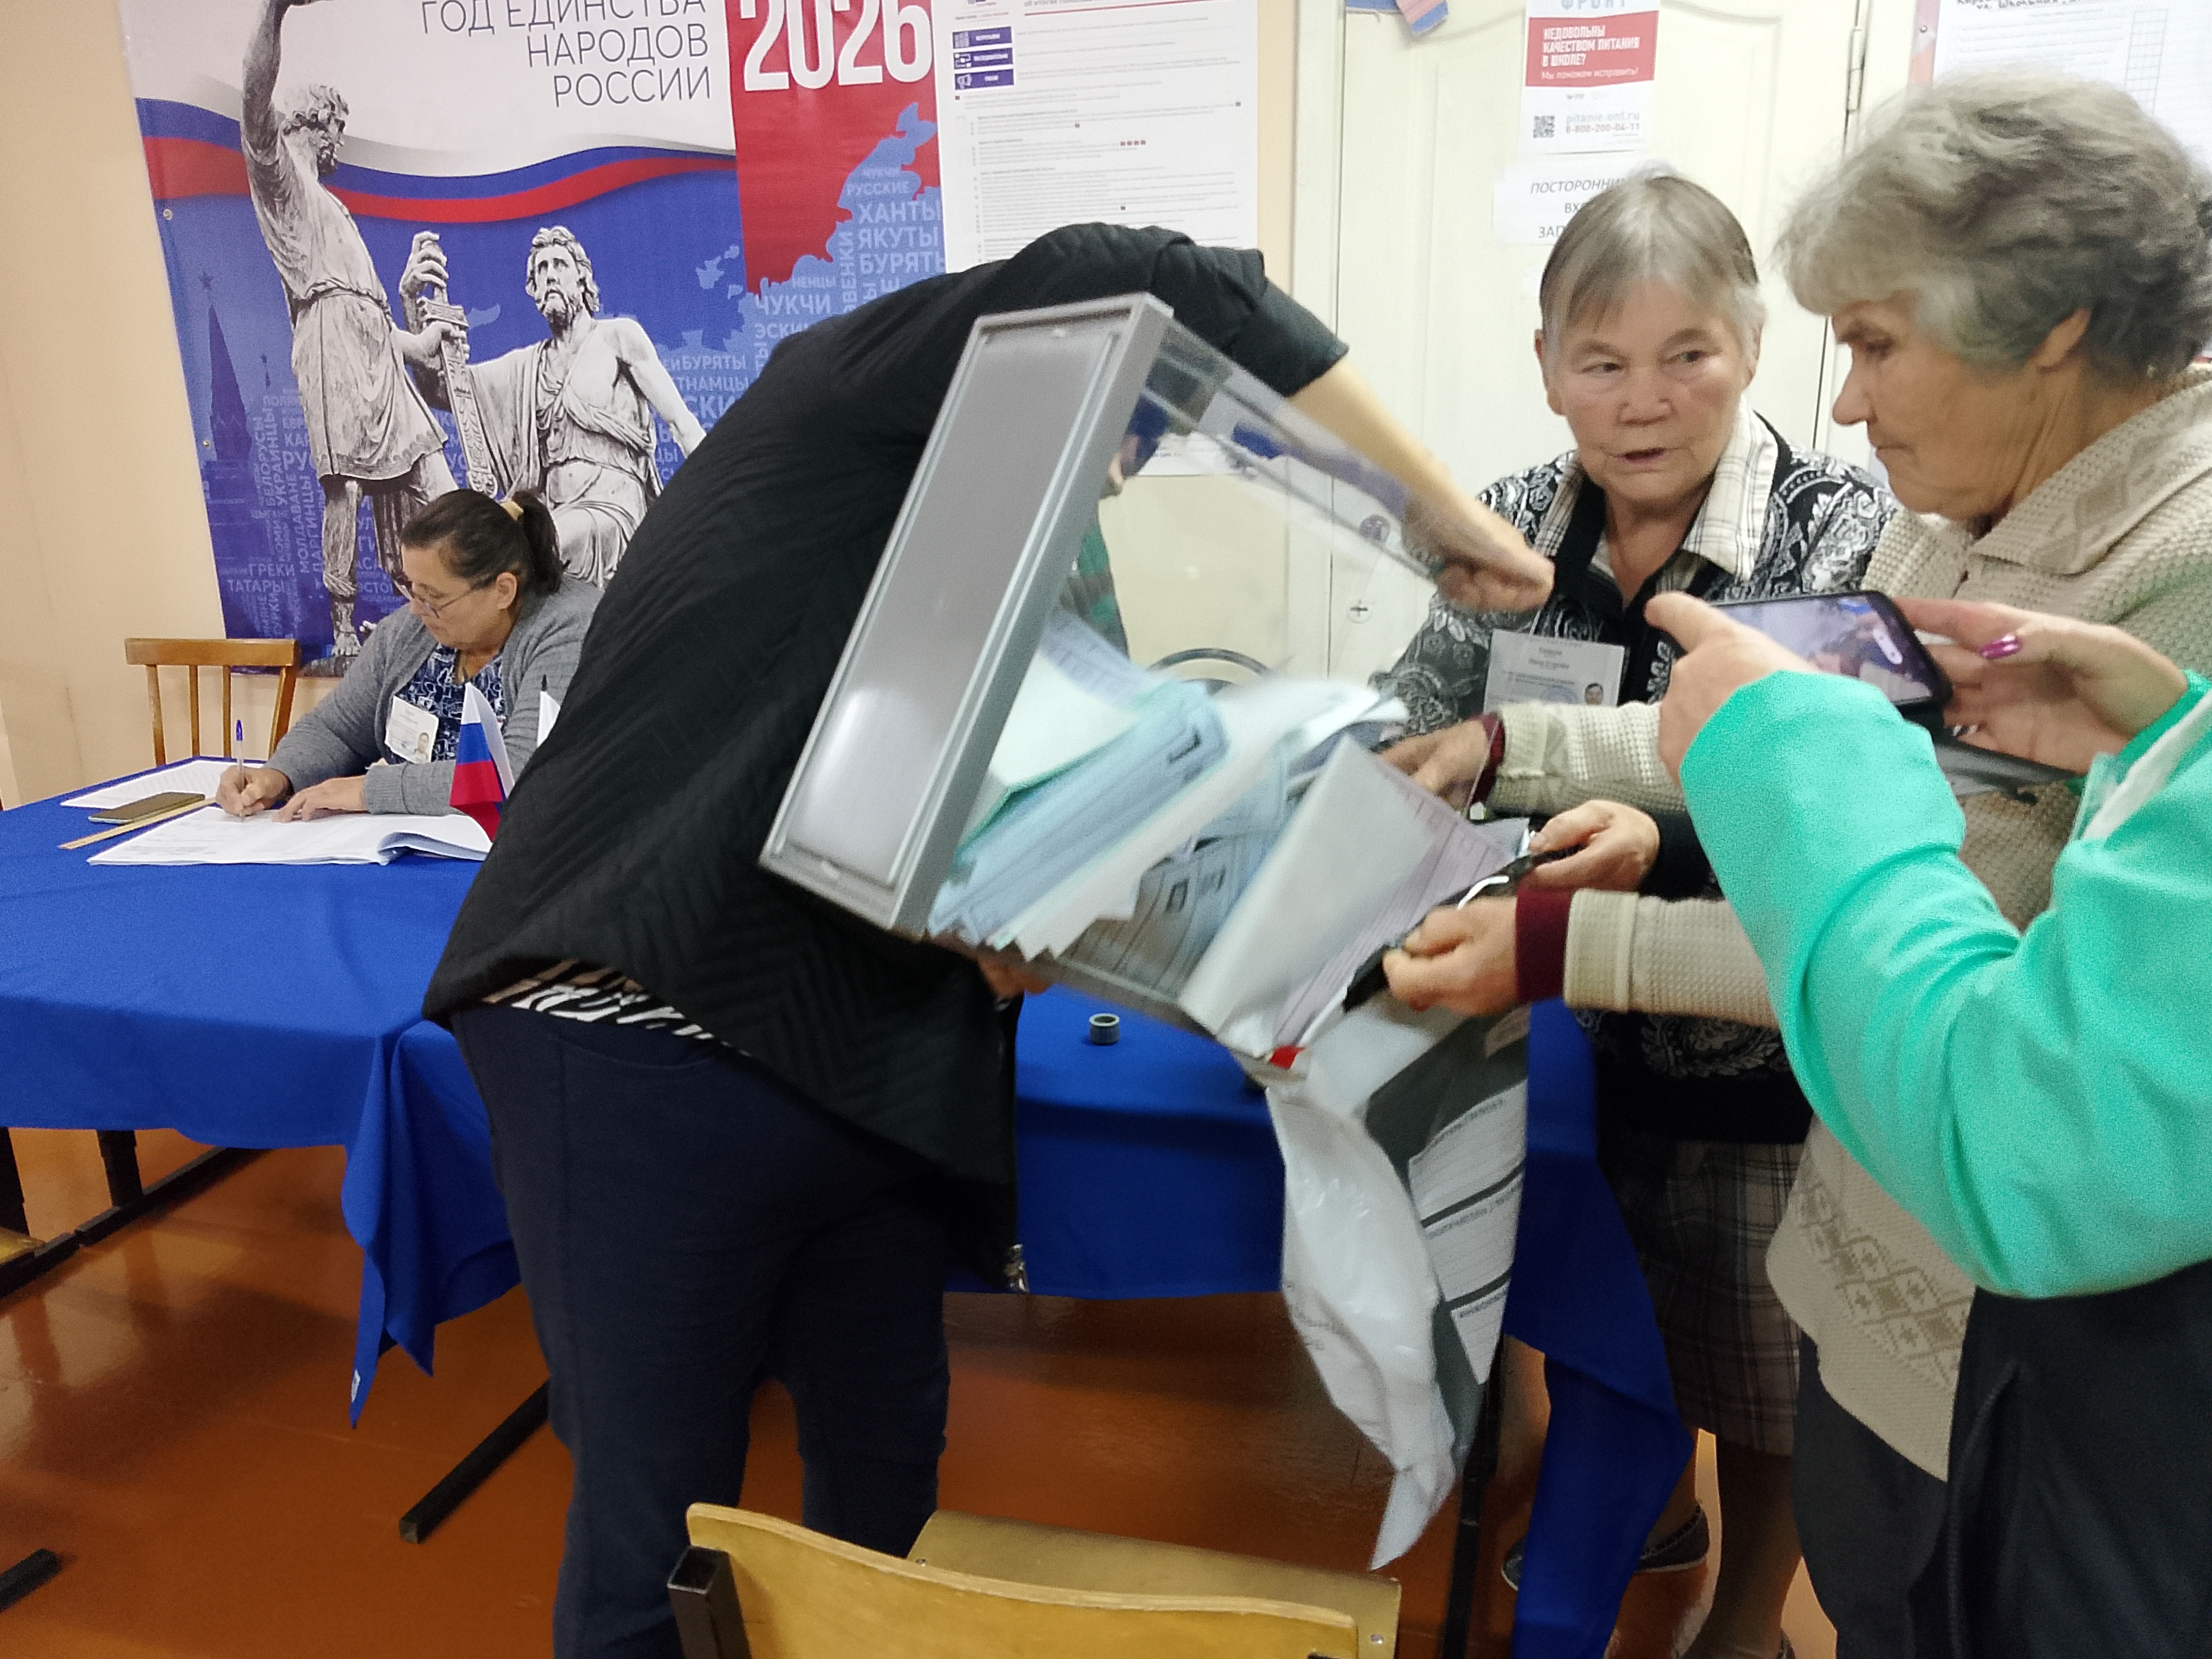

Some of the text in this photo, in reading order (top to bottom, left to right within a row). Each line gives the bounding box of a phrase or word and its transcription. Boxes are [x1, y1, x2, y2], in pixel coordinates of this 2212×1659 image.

[421, 0, 495, 37] ГОД
[1544, 25, 1606, 41] НЕДОВОЛЬНЫ
[527, 24, 709, 68] НАРОДОВ
[744, 0, 933, 91] 2026
[1543, 37, 1640, 53] КАЧЕСТВОМ ПИТАНИЯ
[1542, 53, 1587, 67] В ШКОЛЕ?
[553, 66, 711, 107] РОССИИ
[846, 180, 910, 195] РУССКИЕ
[858, 200, 942, 224] ХАНТЫ
[858, 226, 939, 250] ЯКУТЫ
[754, 294, 831, 315] ЧУКЧИ
[754, 322, 809, 339] ЭСКИ
[682, 354, 747, 370] БУРЯТЫ
[675, 376, 749, 394] ТНАМЦЫ
[252, 416, 276, 507] БЕЛОРУСЫ
[262, 408, 287, 507] УКРАИНЦЫ
[285, 474, 310, 574] МОЛДАВАНЕ
[248, 563, 295, 577] ГРЕКИ
[227, 579, 285, 593] ТАТАРЫ
